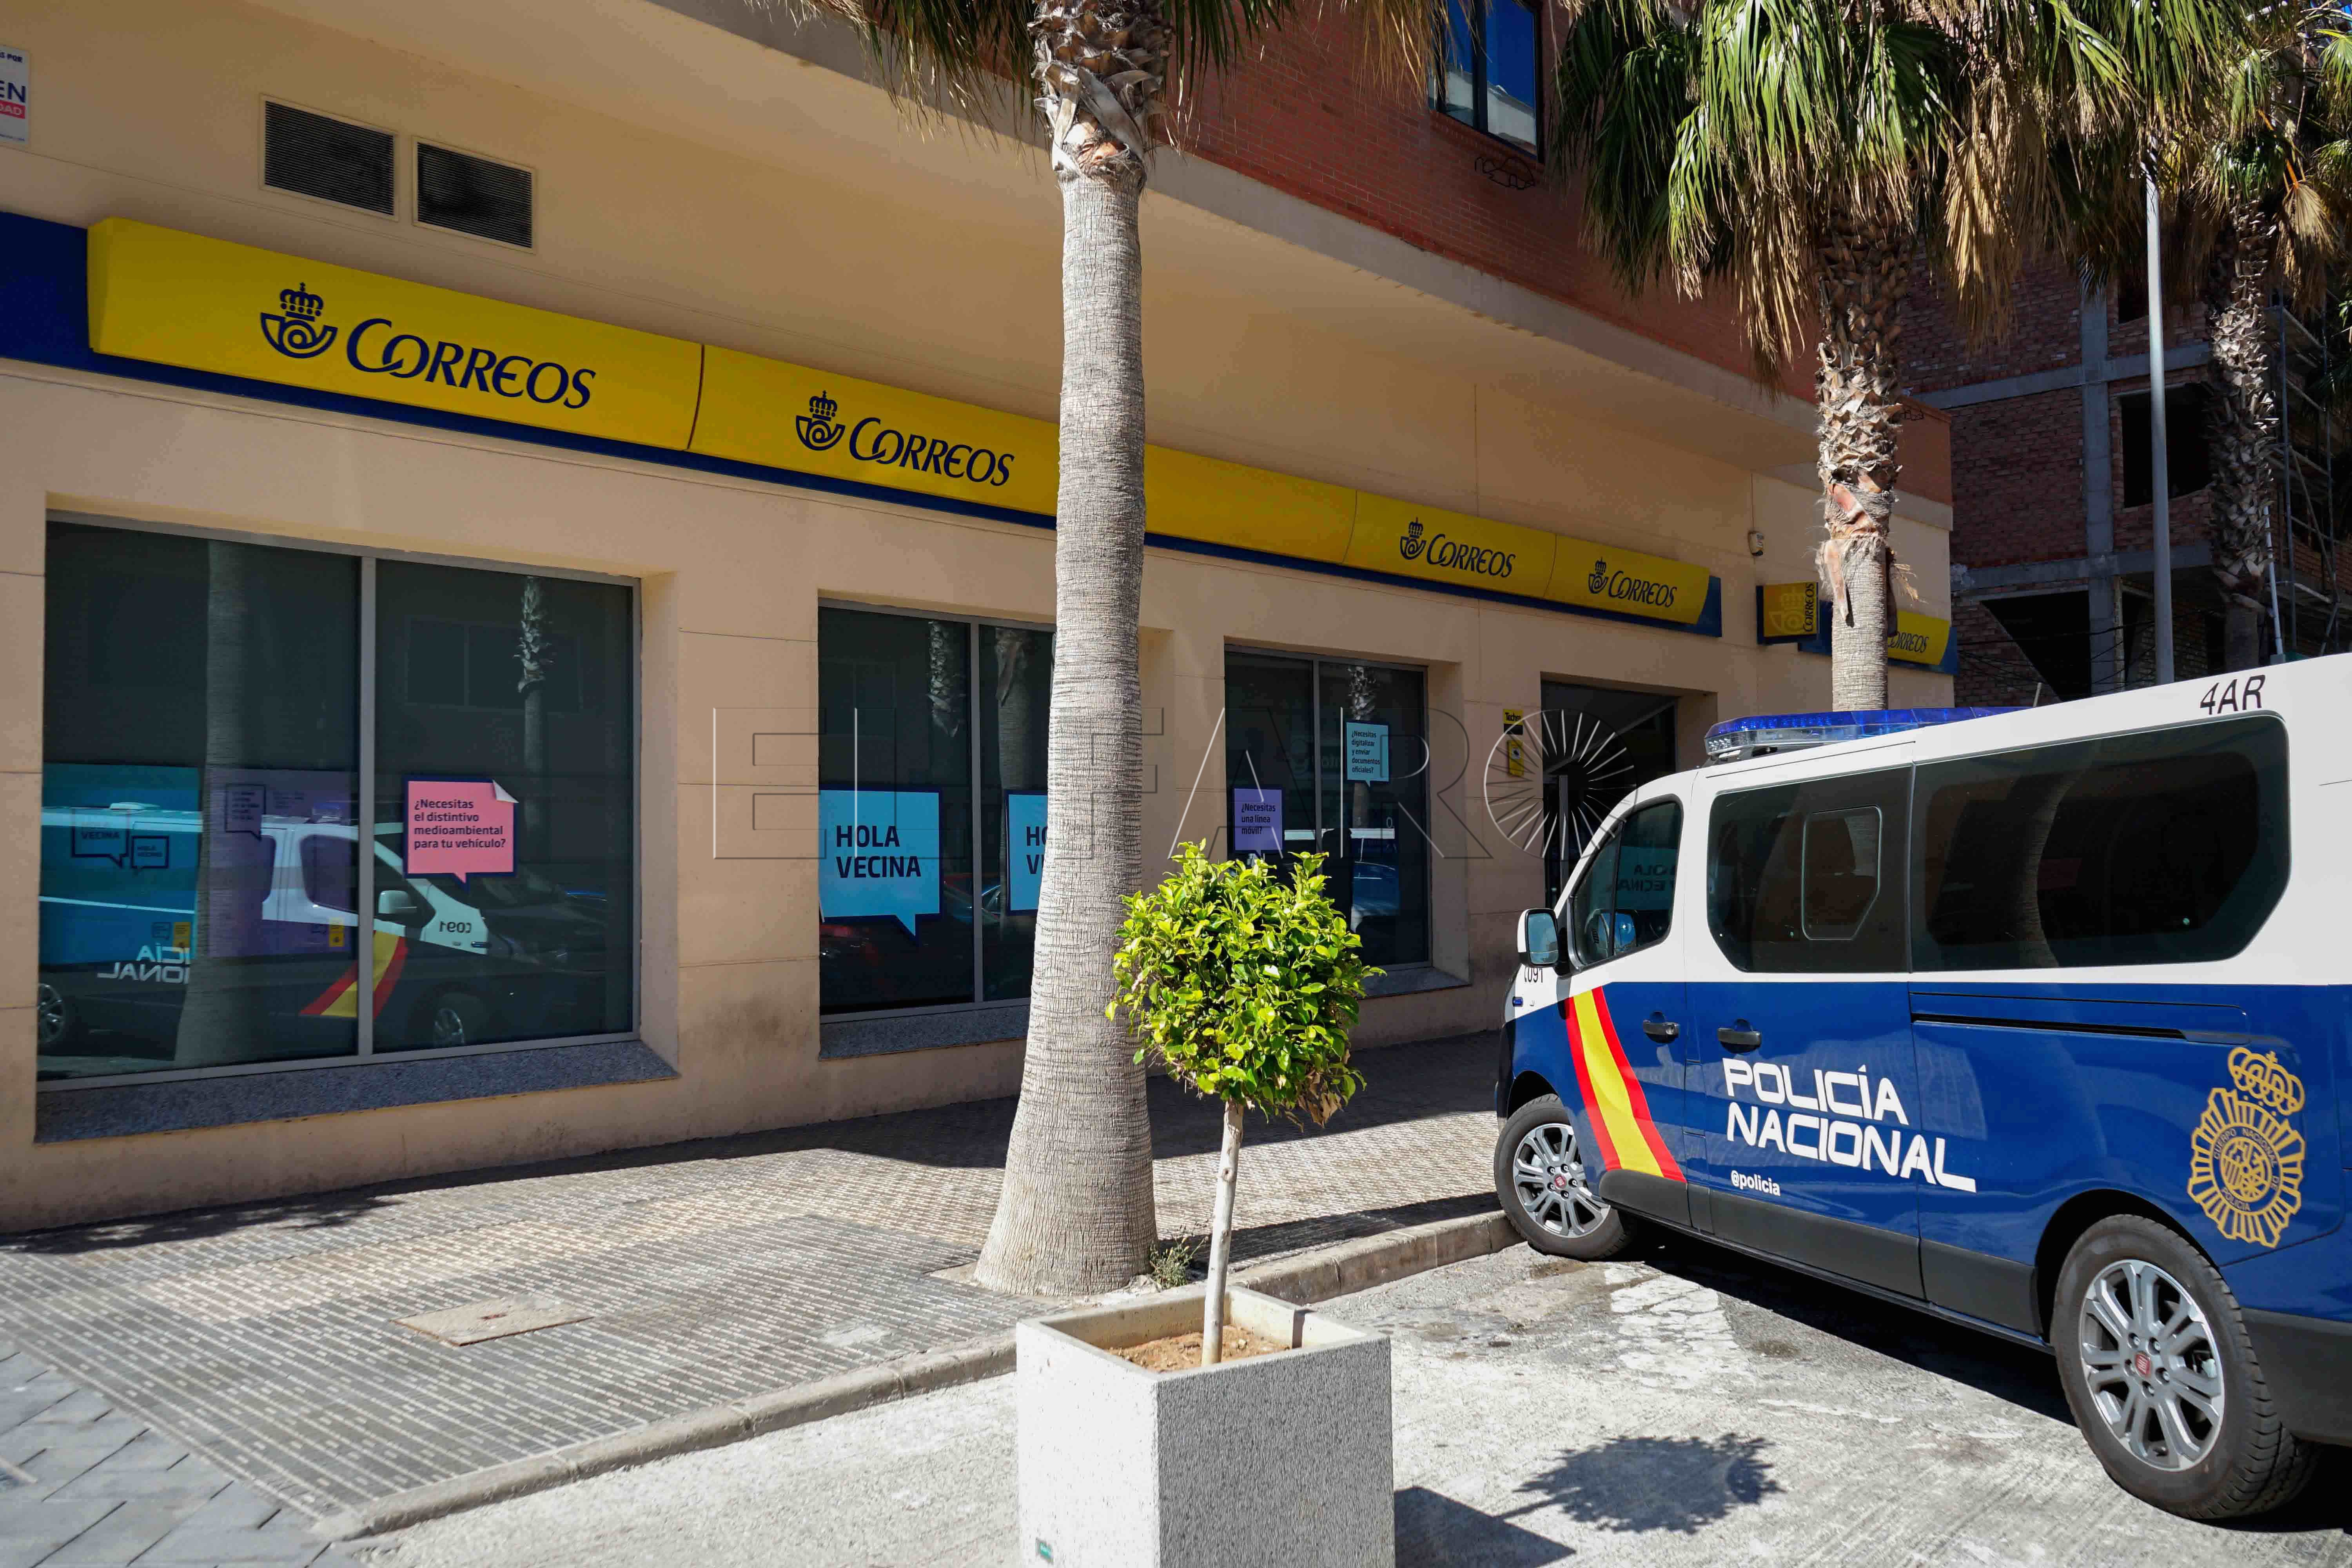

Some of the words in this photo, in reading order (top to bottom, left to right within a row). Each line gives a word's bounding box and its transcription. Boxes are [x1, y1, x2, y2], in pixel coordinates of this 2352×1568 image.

[346, 318, 596, 408] CORREOS
[849, 417, 1015, 486] CORREOS
[1426, 534, 1516, 577] CORREOS
[1608, 570, 1677, 608] CORREOS
[1803, 583, 1814, 632] CORREOS
[1888, 631, 1929, 653] ORREOS
[2200, 674, 2266, 715] 4AR
[414, 799, 474, 810] ¿Necesitas
[414, 812, 424, 821] el
[427, 812, 479, 822] distintivo
[1241, 803, 1276, 813] ¿Necesitas
[414, 826, 503, 835] medioambiental
[836, 825, 900, 847] HOLA
[1241, 826, 1262, 835] móvil?
[414, 840, 439, 850] para
[441, 839, 453, 848] tu
[455, 838, 506, 848] vehículo?
[836, 855, 921, 878] VECINA
[1722, 1058, 1909, 1125] POLICÍA
[1727, 1102, 1976, 1193] NACIONAL
[2214, 1128, 2237, 1160] CUERPO
[2242, 1128, 2278, 1168] NACIONAL
[1731, 1170, 1781, 1196] @policia
